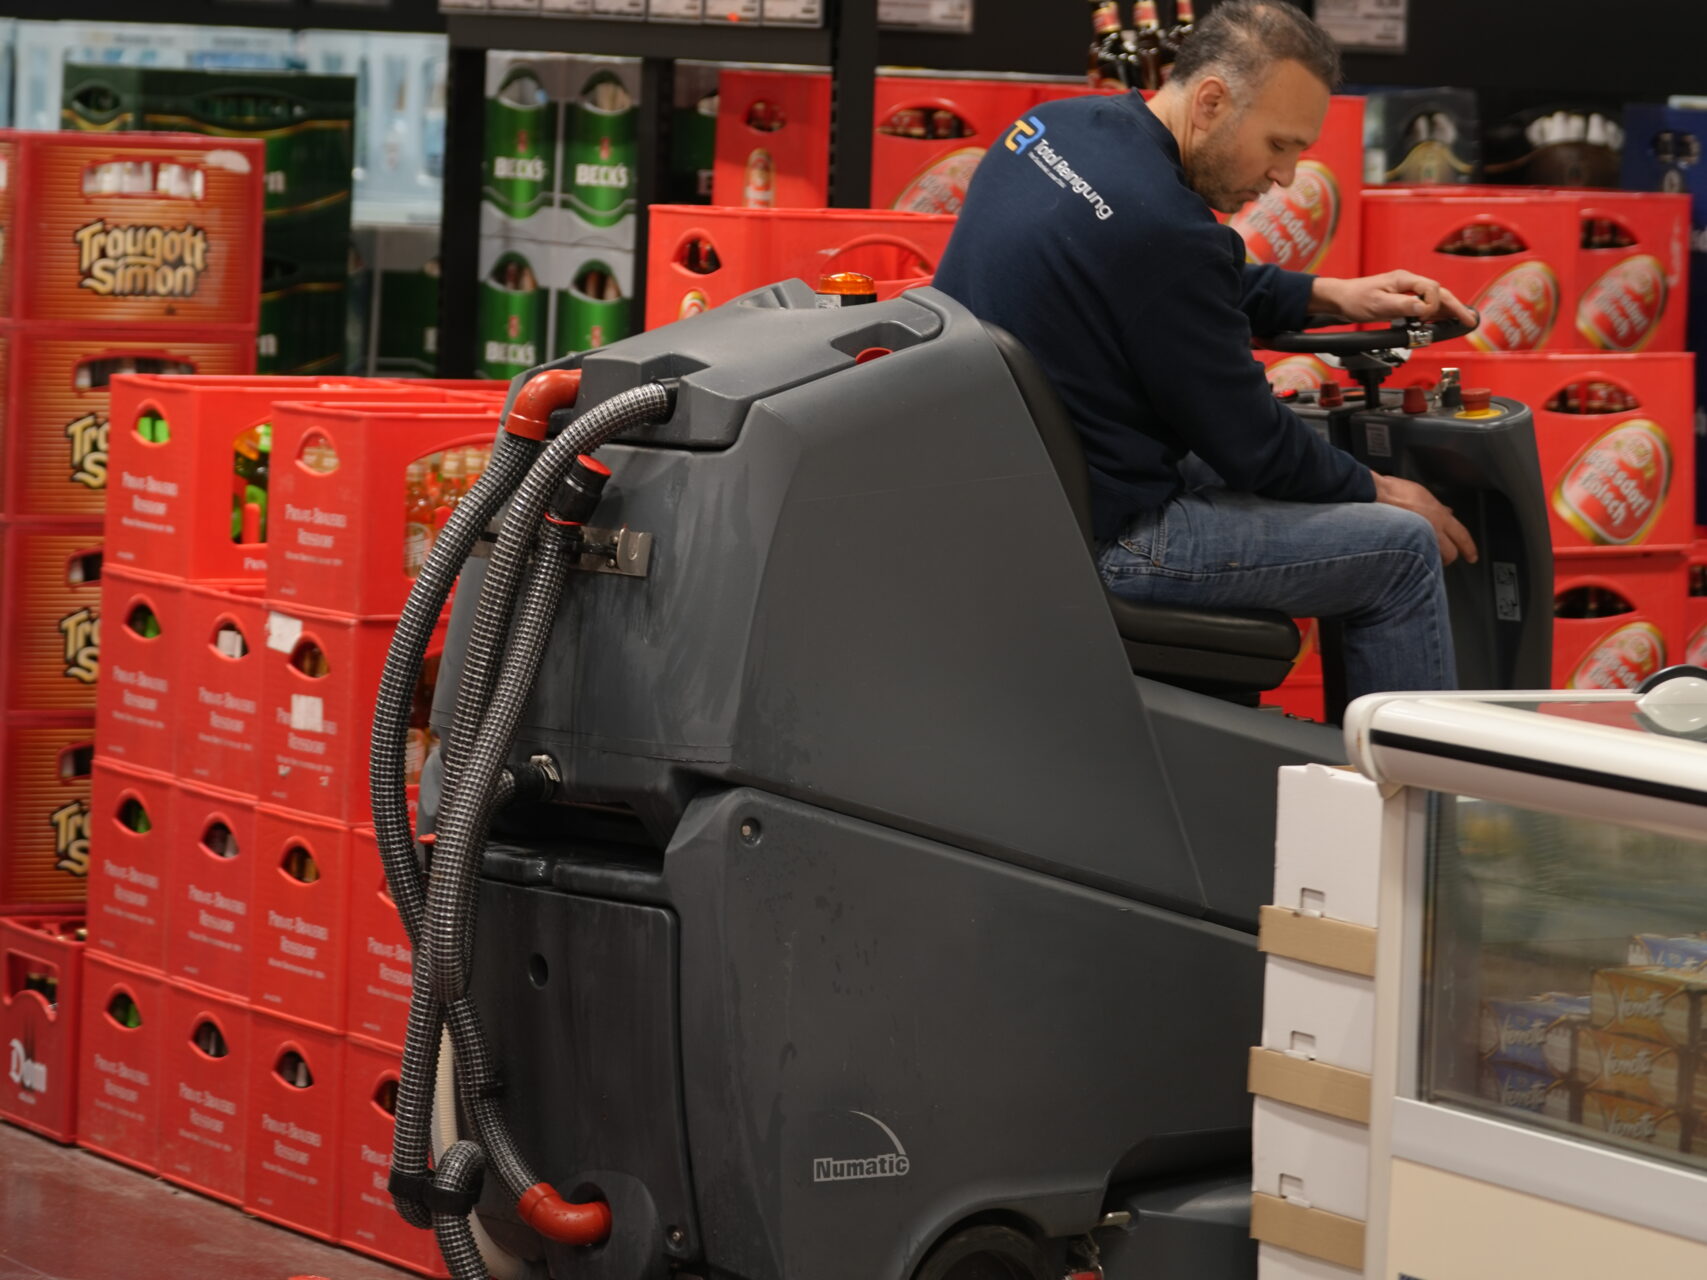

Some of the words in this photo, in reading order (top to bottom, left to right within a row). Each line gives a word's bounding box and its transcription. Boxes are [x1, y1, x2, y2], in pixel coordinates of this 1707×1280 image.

[1034, 138, 1064, 167] Total
[1053, 160, 1114, 220] Reinigung
[82, 257, 197, 296] Simon
[8, 1038, 47, 1094] Dom
[813, 1153, 910, 1182] Numatic
